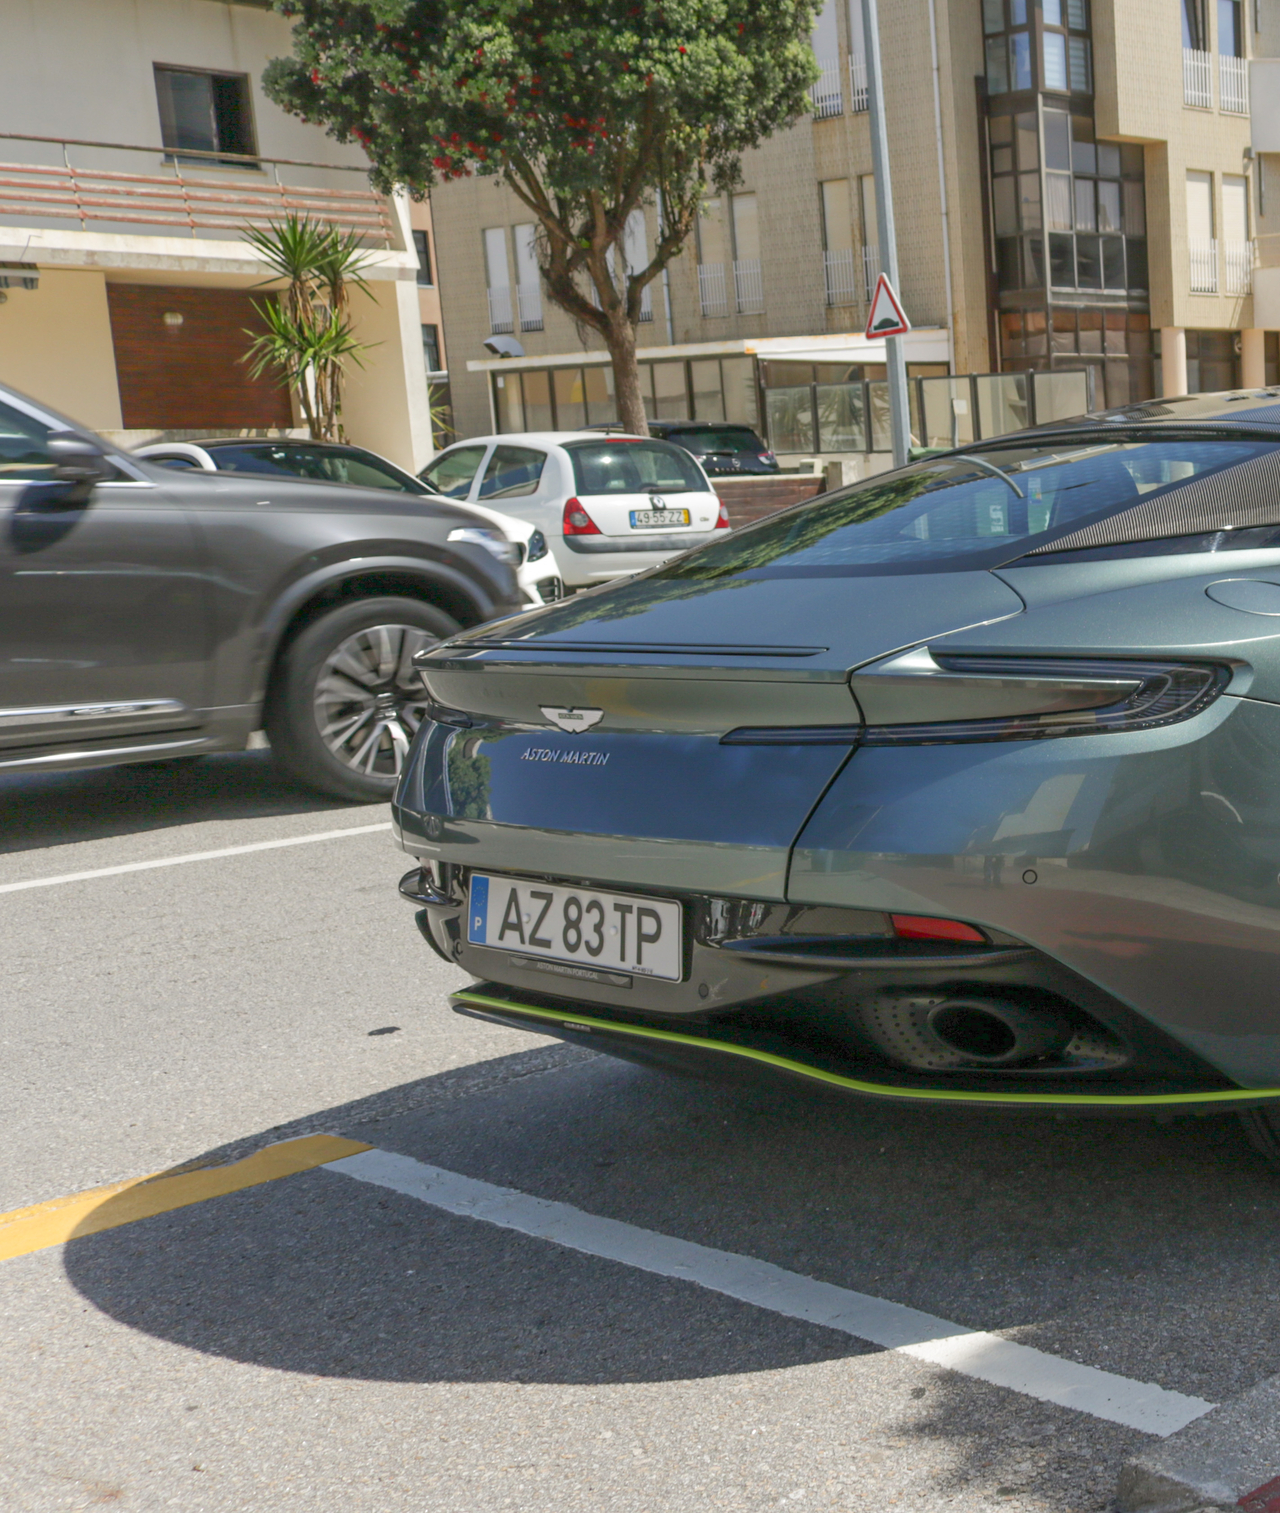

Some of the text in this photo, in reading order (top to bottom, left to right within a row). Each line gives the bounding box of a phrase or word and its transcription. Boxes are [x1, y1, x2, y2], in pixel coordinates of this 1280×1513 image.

[520, 747, 611, 766] ASTON MARTIN
[473, 916, 483, 931] P
[498, 887, 662, 966] AZ 83 TP
[536, 961, 599, 980] ASTON MARTIN PORTUGAL
